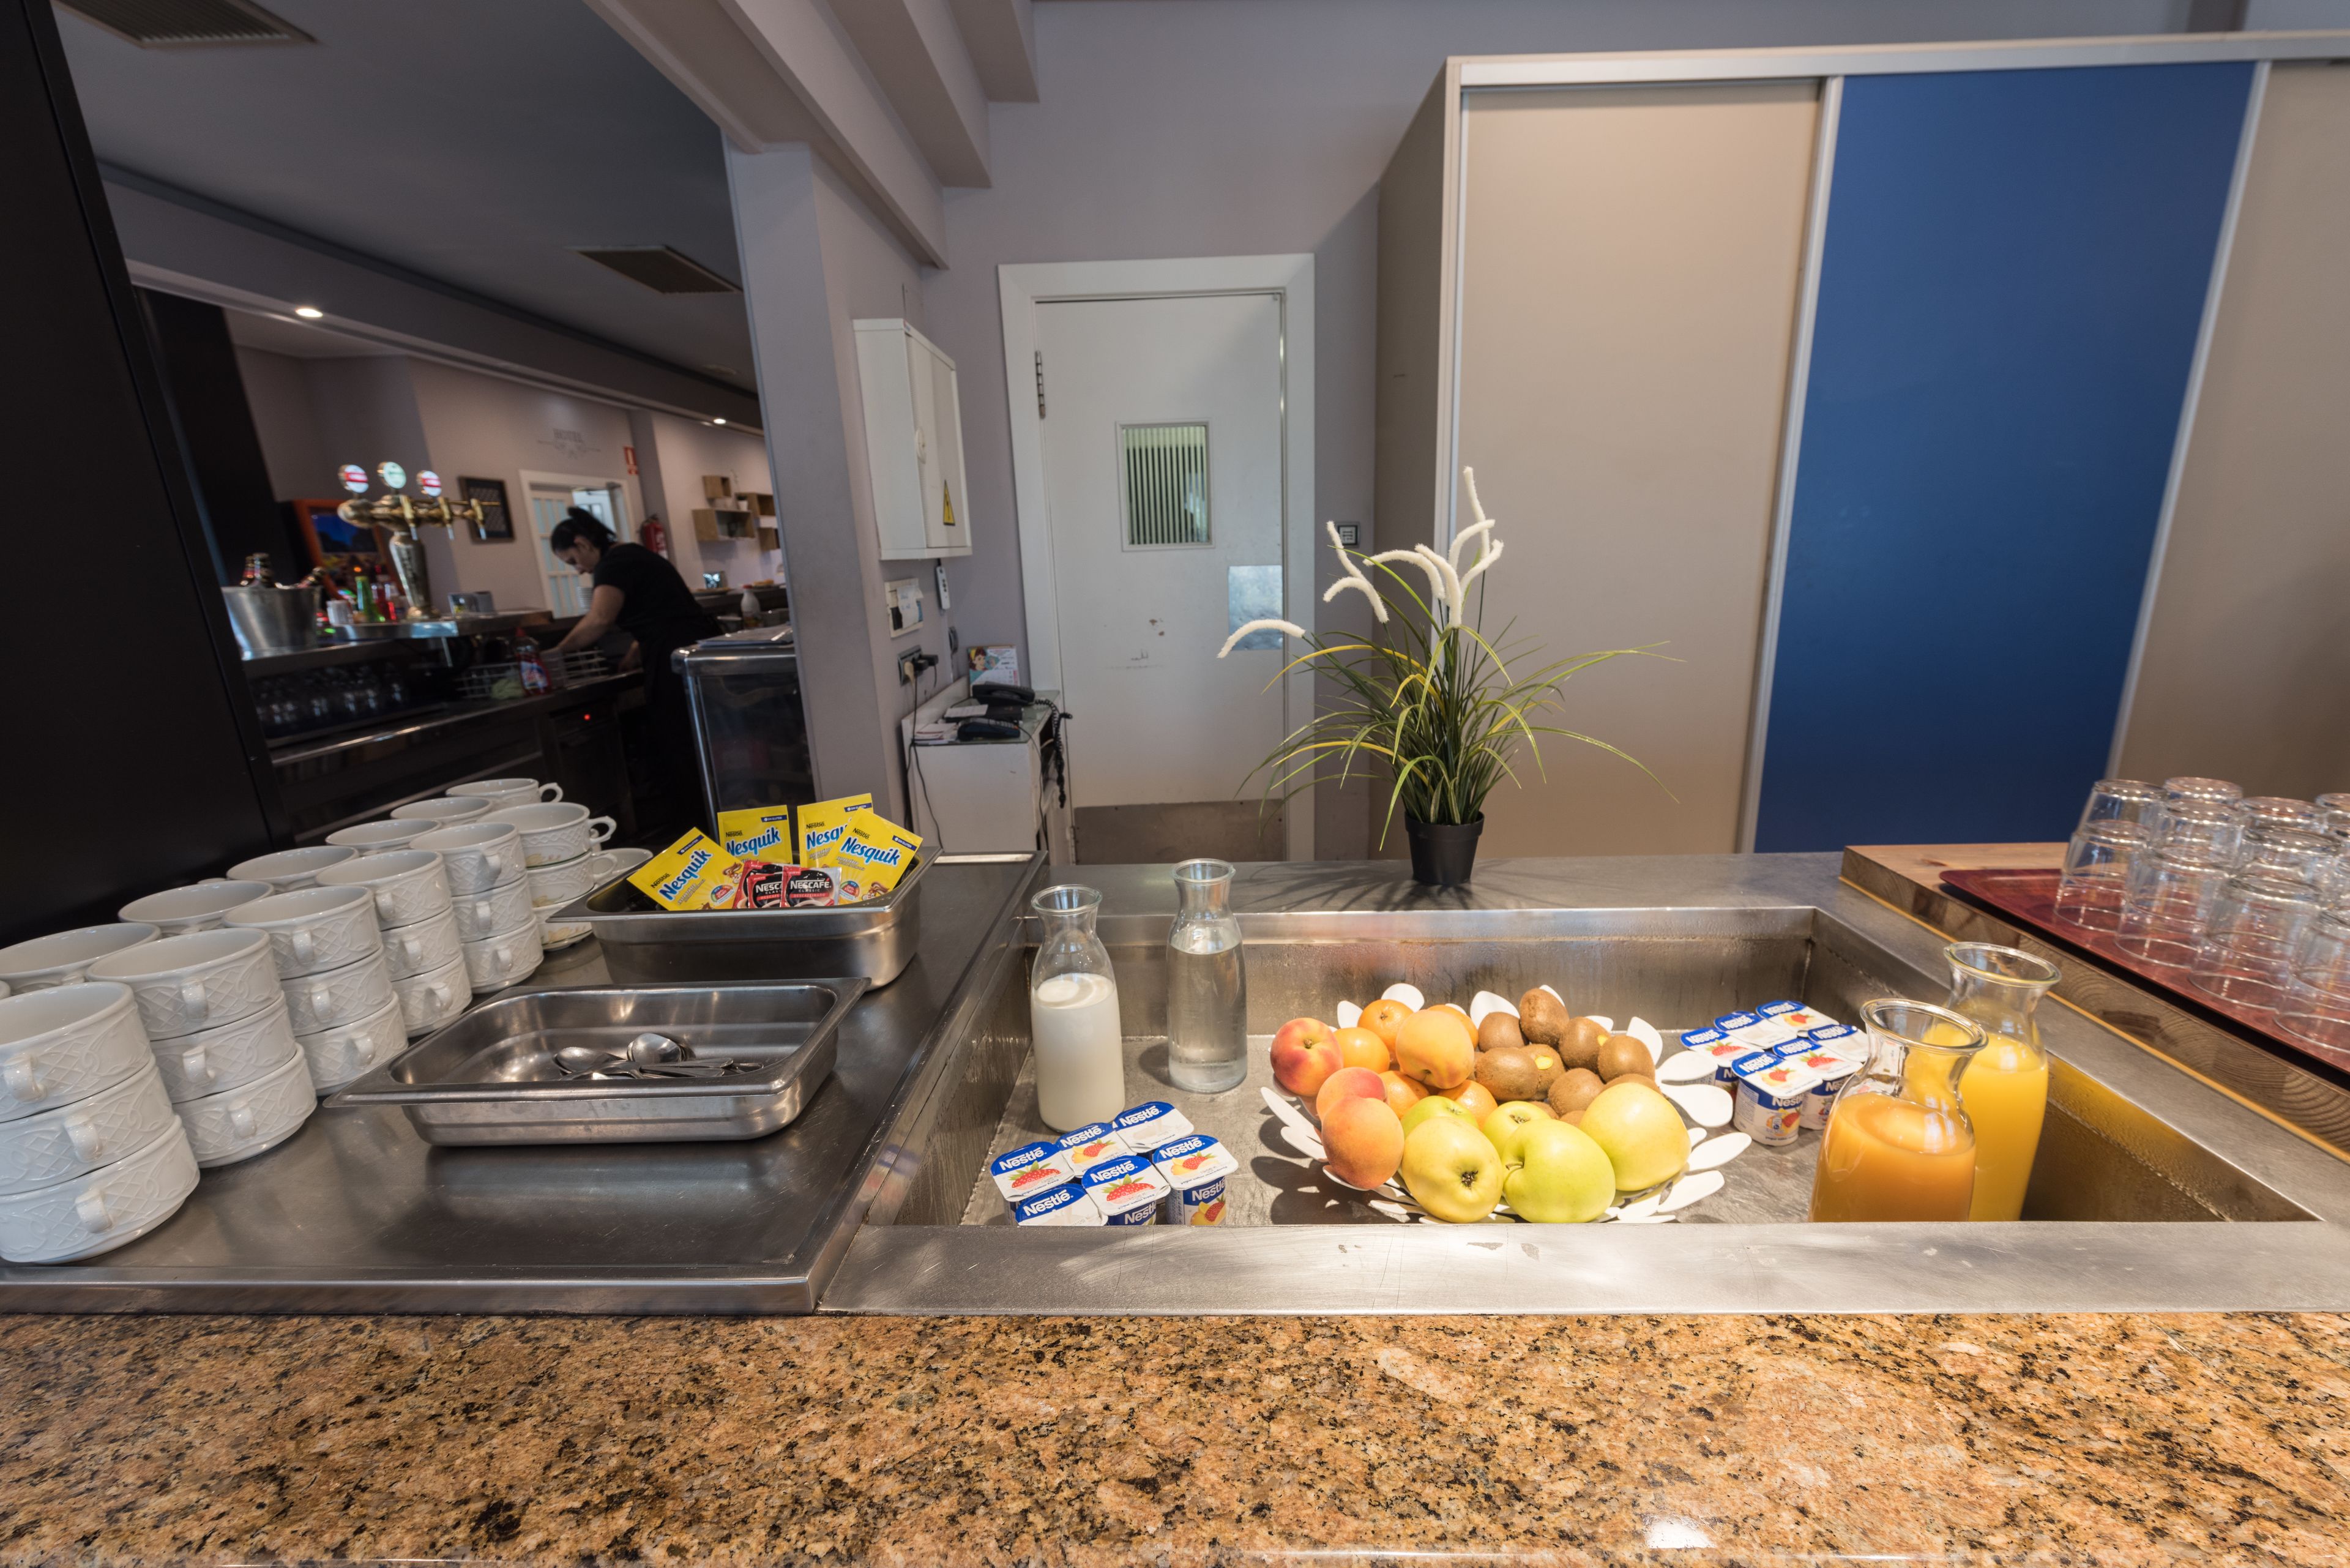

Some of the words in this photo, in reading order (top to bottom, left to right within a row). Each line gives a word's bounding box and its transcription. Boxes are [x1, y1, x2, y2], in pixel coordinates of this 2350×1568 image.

[726, 827, 781, 856] Nesquik
[841, 837, 900, 865] Nesquik
[658, 850, 712, 901] Nesquik
[790, 878, 830, 889] NESCAFÉ
[756, 881, 782, 893] NESC
[1119, 1105, 1159, 1126] Nestlé
[1060, 1126, 1102, 1148] Nestlé
[999, 1147, 1044, 1170] Nestlé
[1160, 1138, 1202, 1159] Nestlé
[1090, 1160, 1135, 1182] Nestlé
[1023, 1189, 1071, 1216] Nestlé
